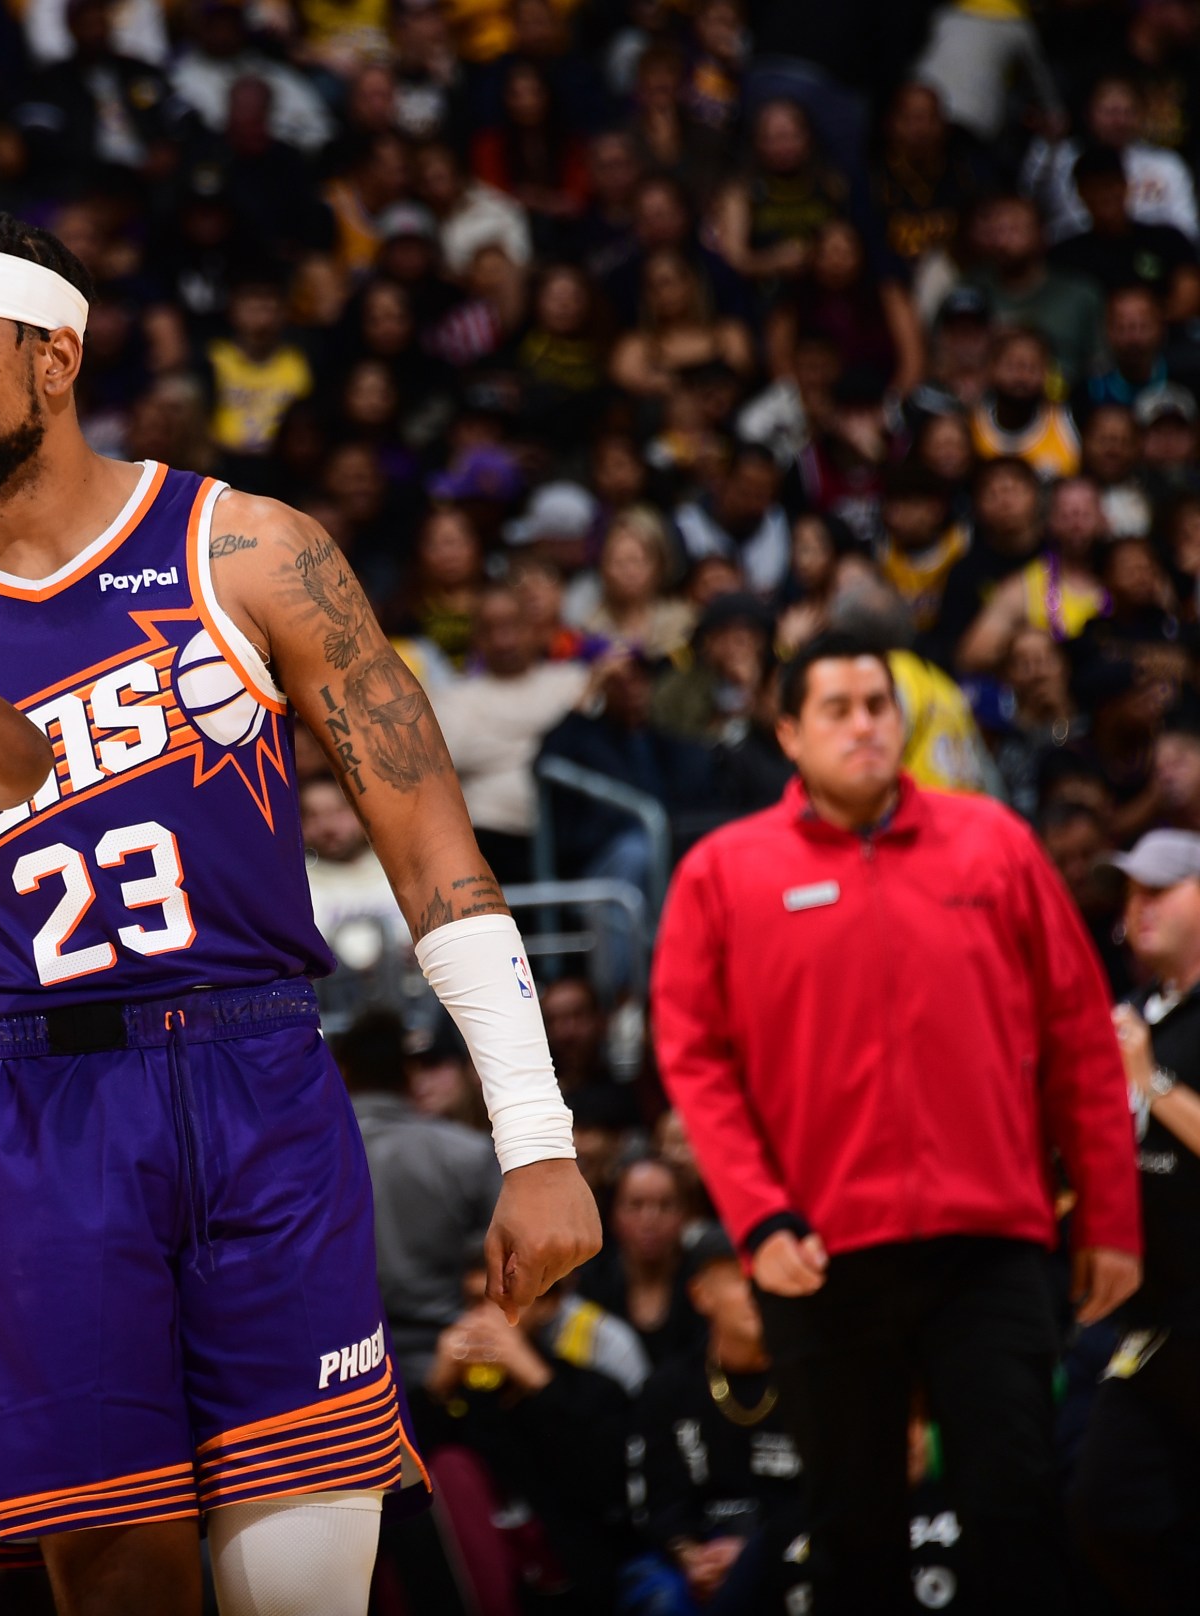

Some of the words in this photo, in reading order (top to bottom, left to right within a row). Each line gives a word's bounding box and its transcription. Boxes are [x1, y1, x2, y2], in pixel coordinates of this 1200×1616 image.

[98, 566, 179, 594] PayPal
[319, 685, 367, 795] INRI
[11, 820, 198, 988] 23
[318, 1321, 386, 1390] PHOE
